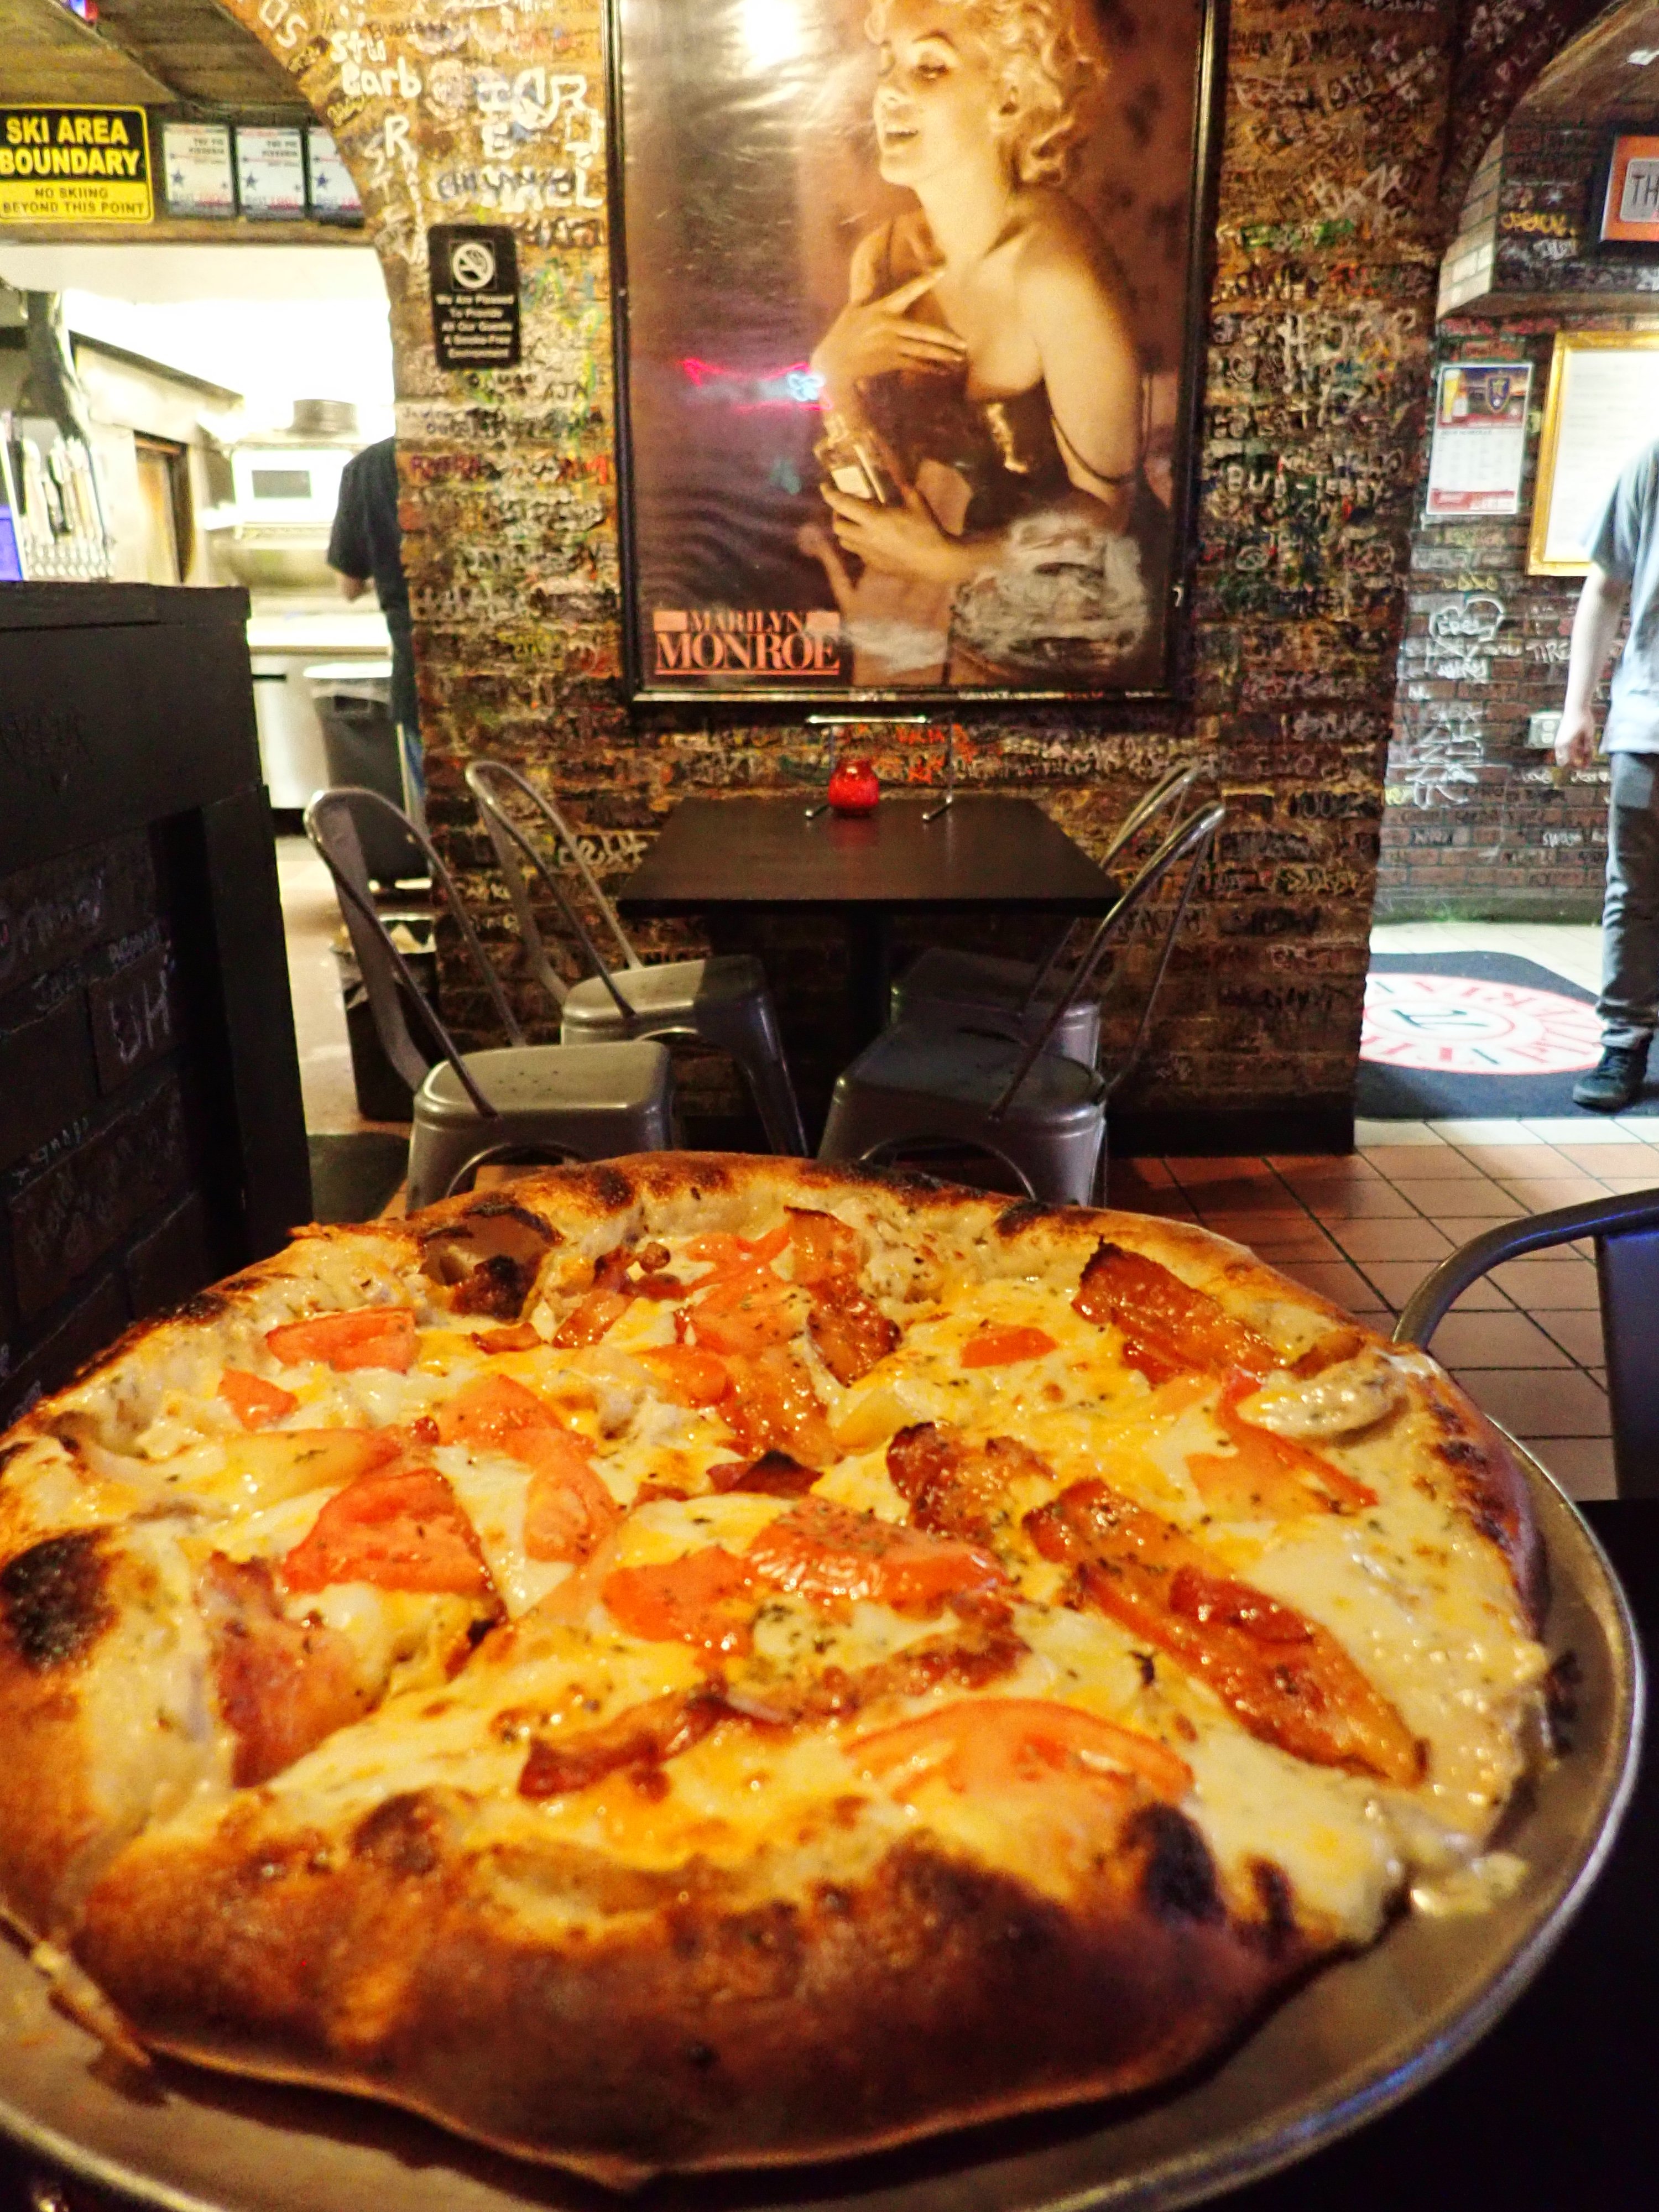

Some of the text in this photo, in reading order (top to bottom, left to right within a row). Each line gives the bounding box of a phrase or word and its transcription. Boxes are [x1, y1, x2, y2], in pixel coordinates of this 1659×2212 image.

[6, 116, 129, 145] SKI AREA
[0, 147, 142, 176] BOUNDARY
[34, 187, 109, 199] NO SKIING
[3, 201, 144, 215] BEYOND THIS POINT
[689, 610, 805, 633] MARILYN
[656, 632, 841, 670] MONROE
